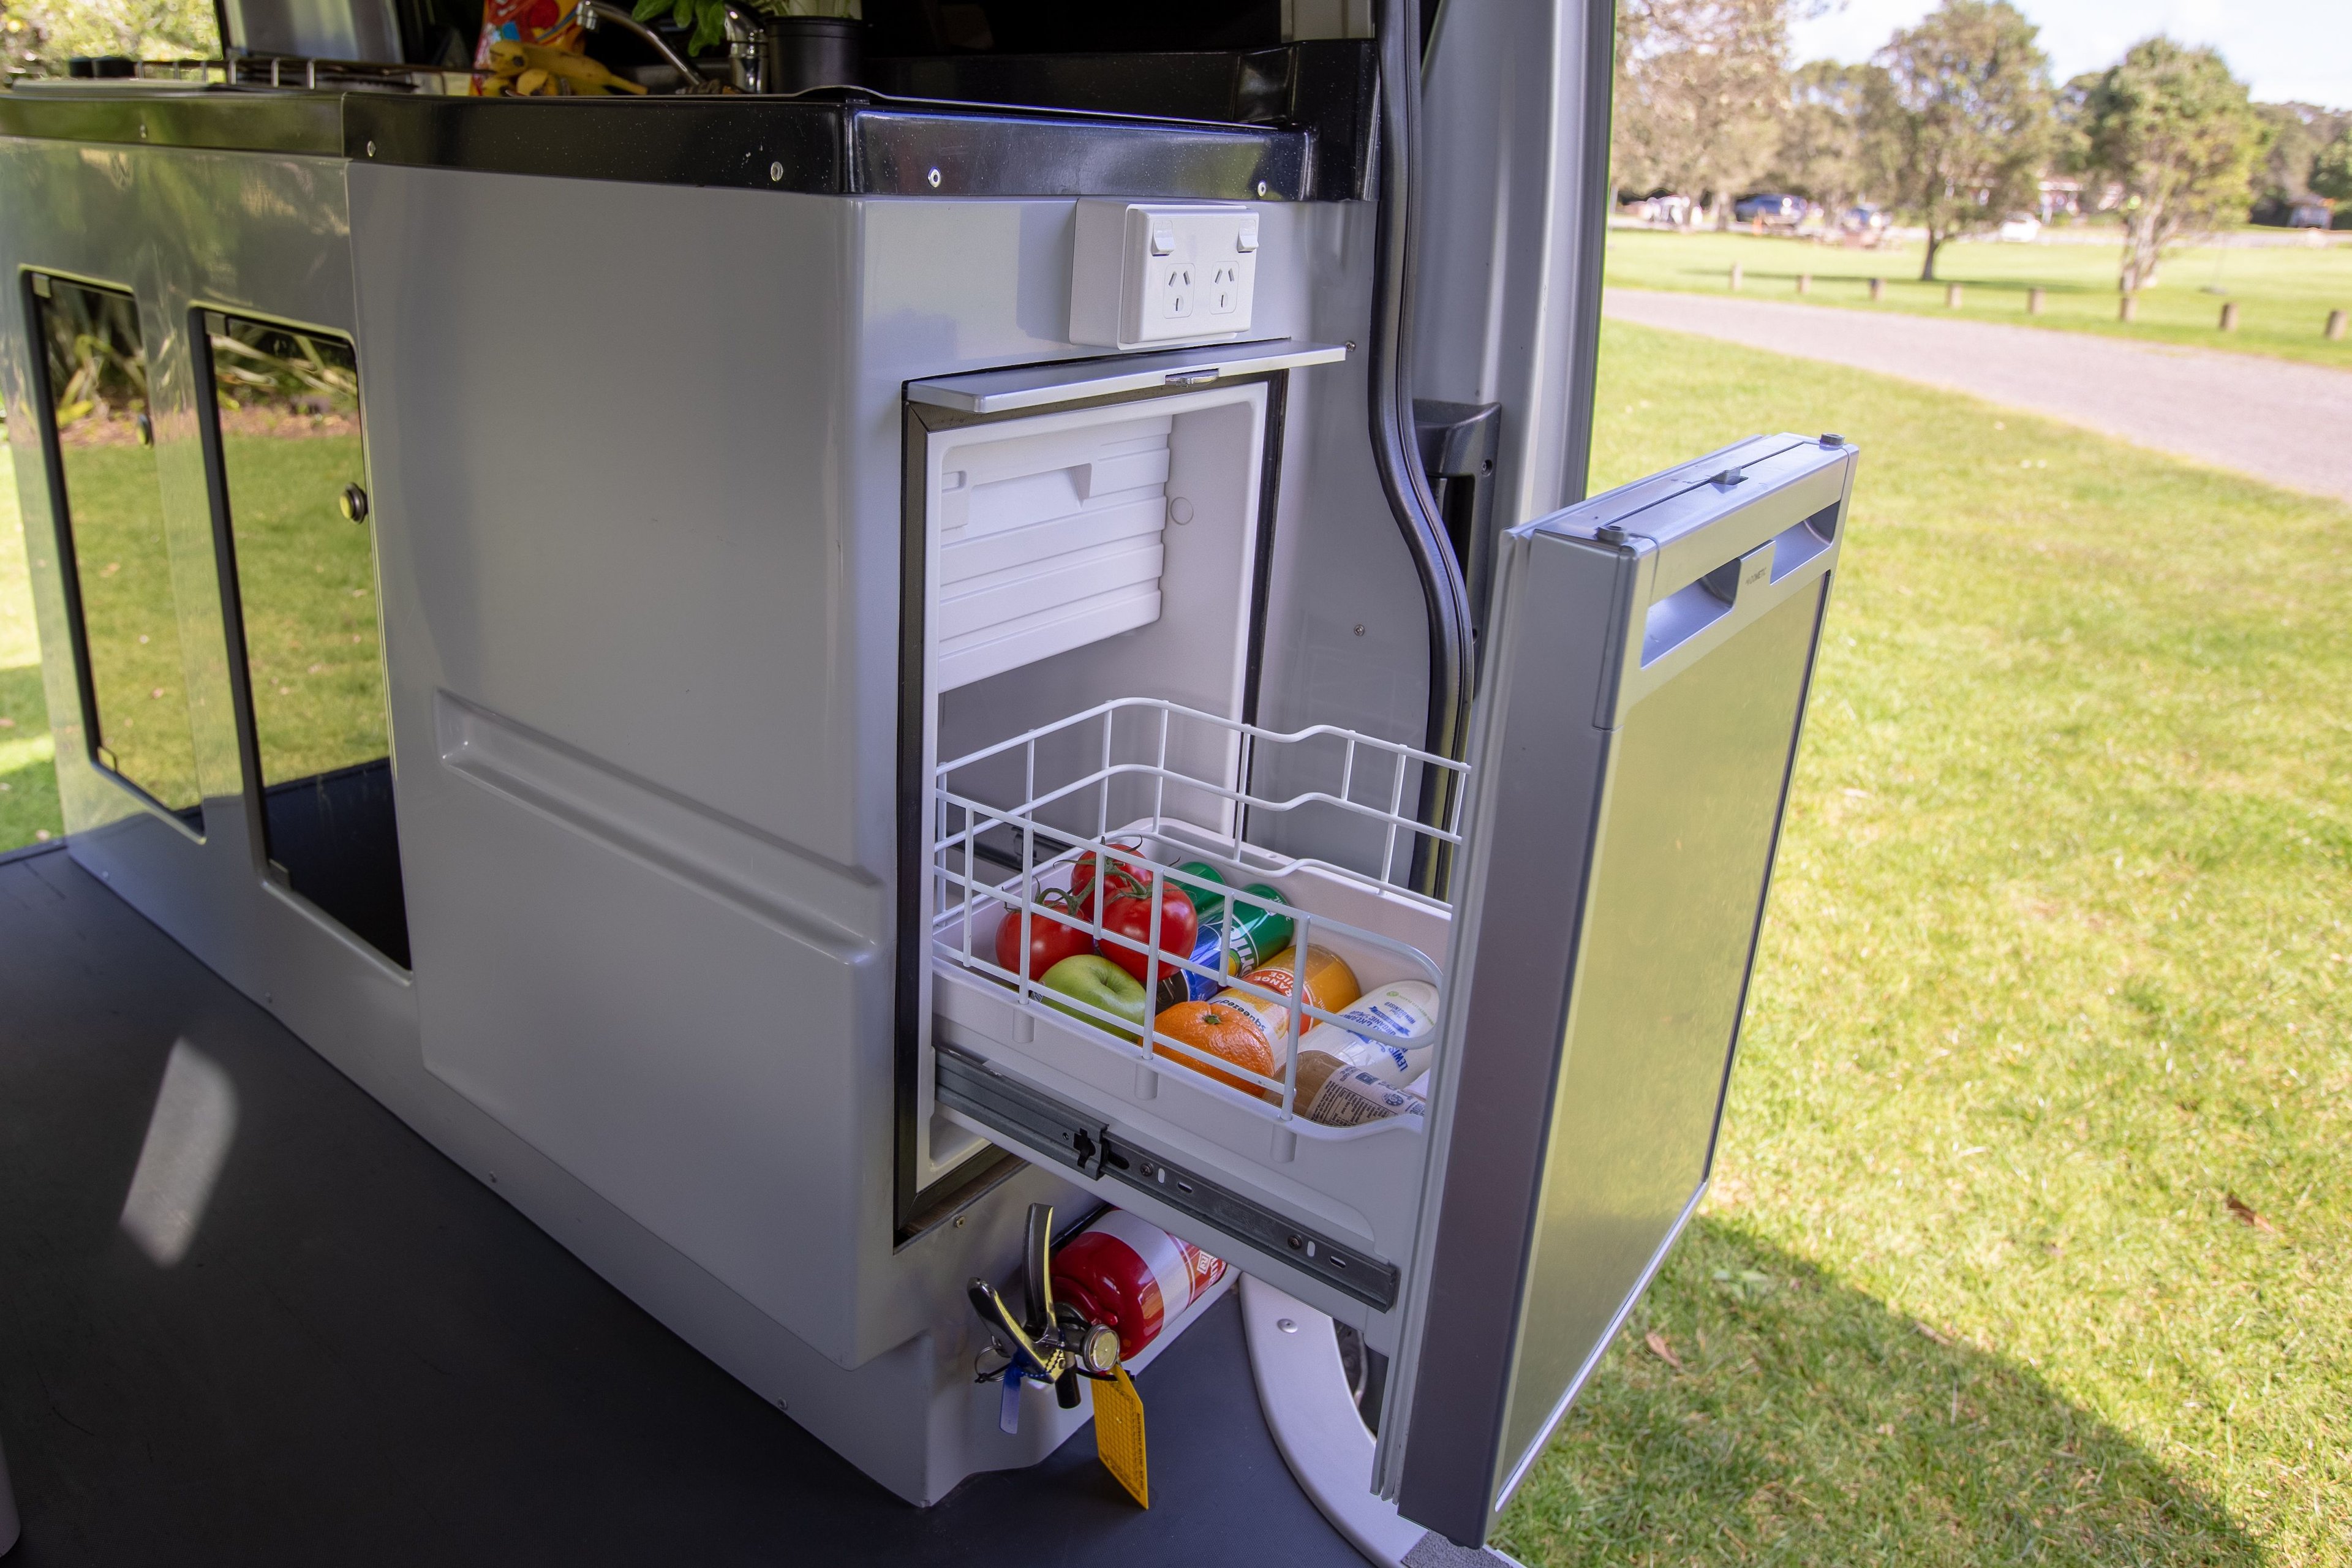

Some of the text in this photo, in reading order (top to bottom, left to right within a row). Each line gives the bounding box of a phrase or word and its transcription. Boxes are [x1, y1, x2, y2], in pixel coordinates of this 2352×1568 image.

[1254, 976, 1292, 997] RANGE
[1220, 999, 1266, 1031] squeezed
[1388, 1046, 1408, 1071] LEWIS
